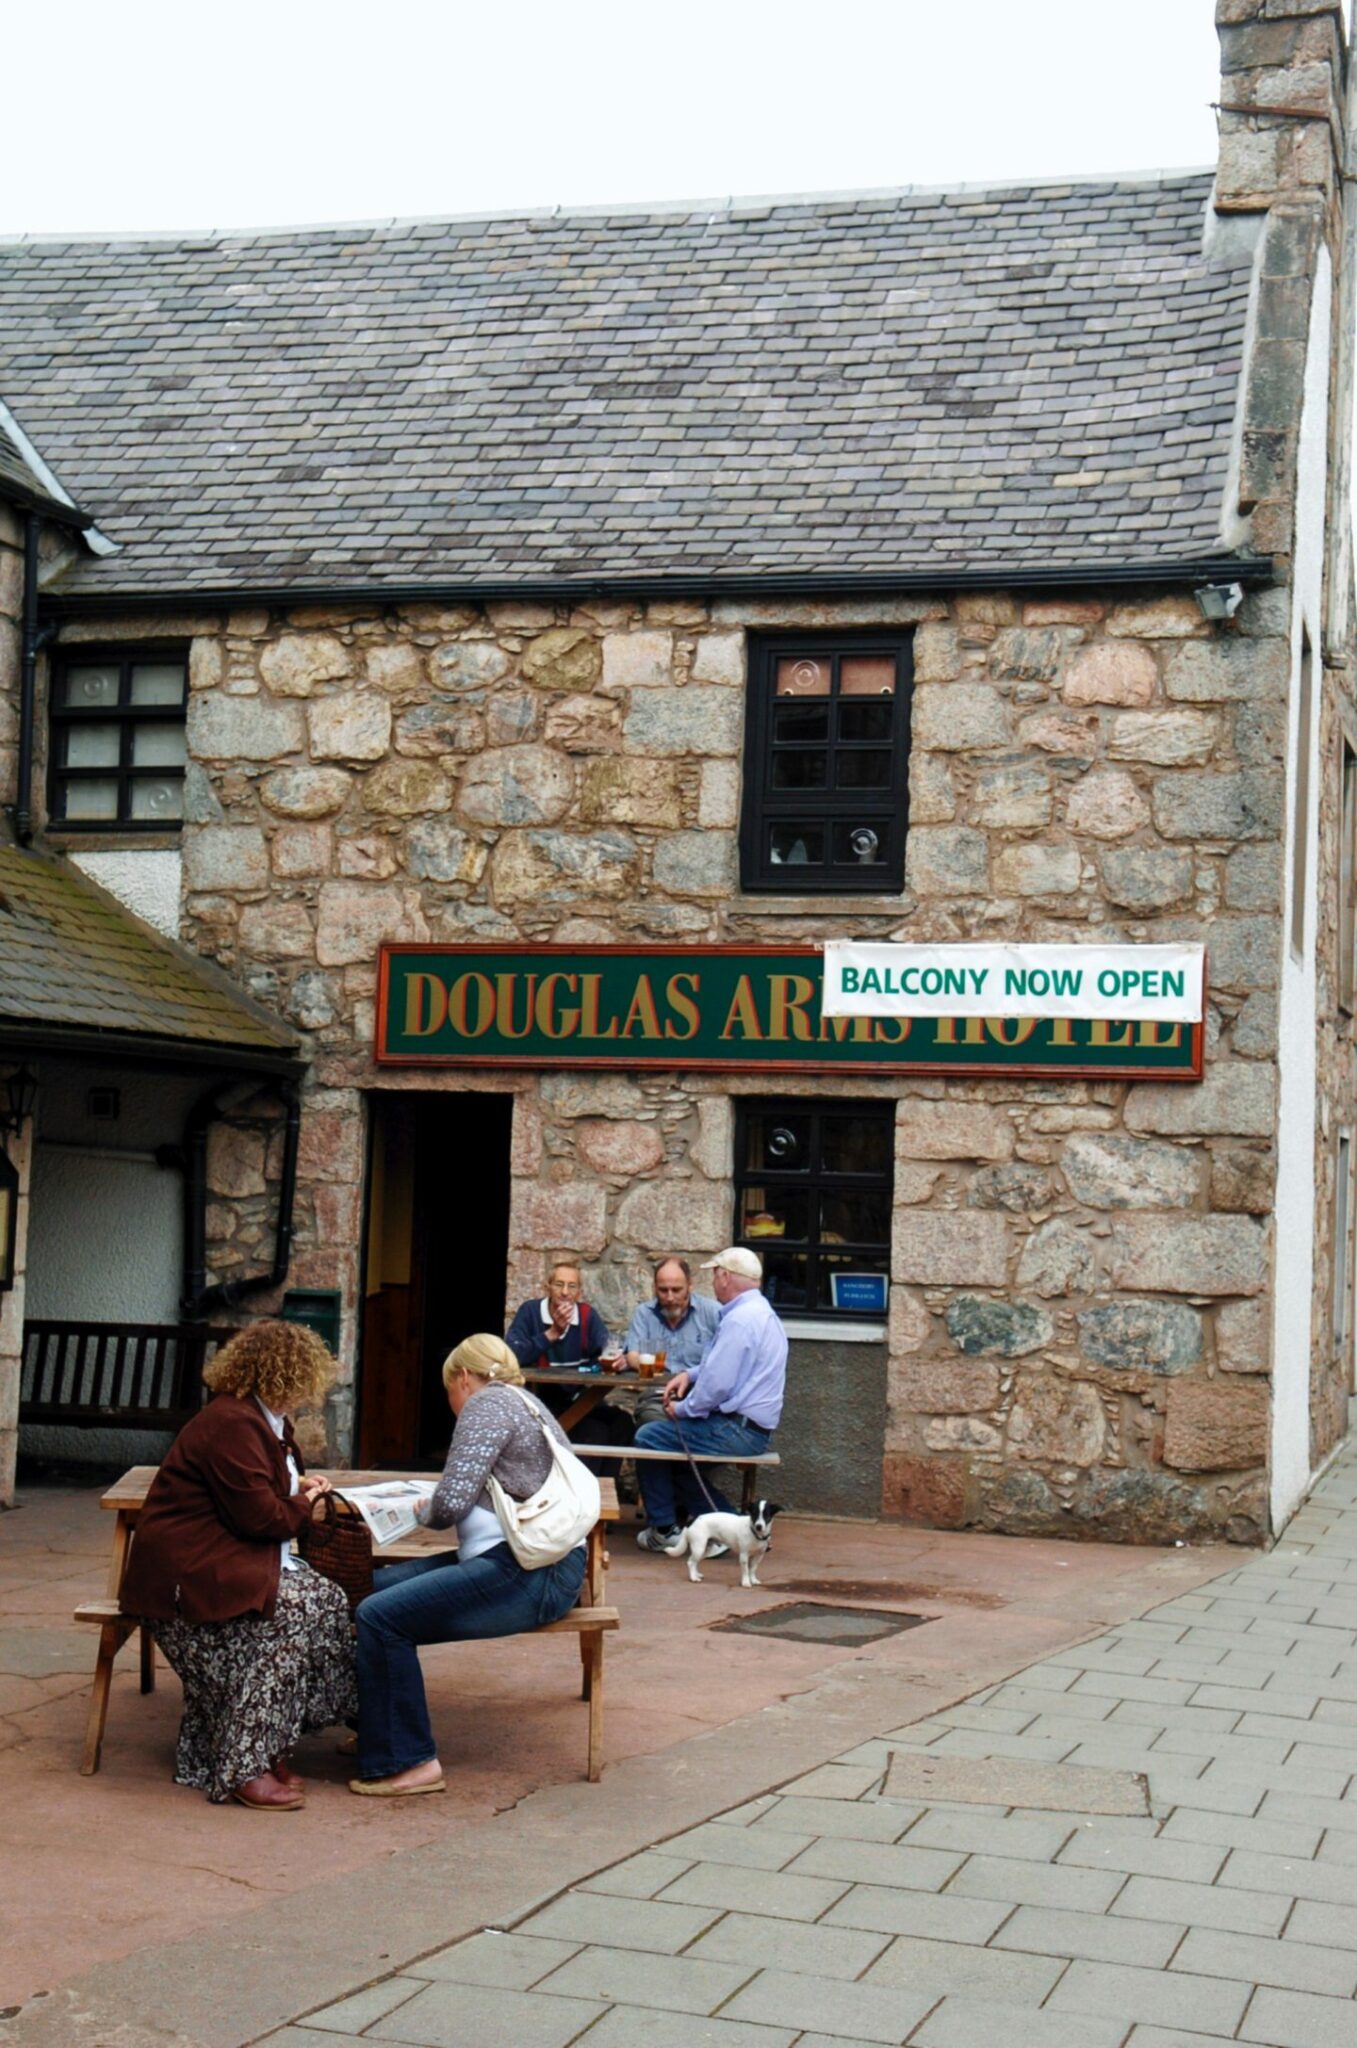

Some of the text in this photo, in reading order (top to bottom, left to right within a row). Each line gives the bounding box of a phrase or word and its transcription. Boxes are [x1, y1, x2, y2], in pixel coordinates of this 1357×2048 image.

[402, 972, 699, 1040] DOUGLAS
[841, 967, 1184, 997] BALCONY NOW OPEN
